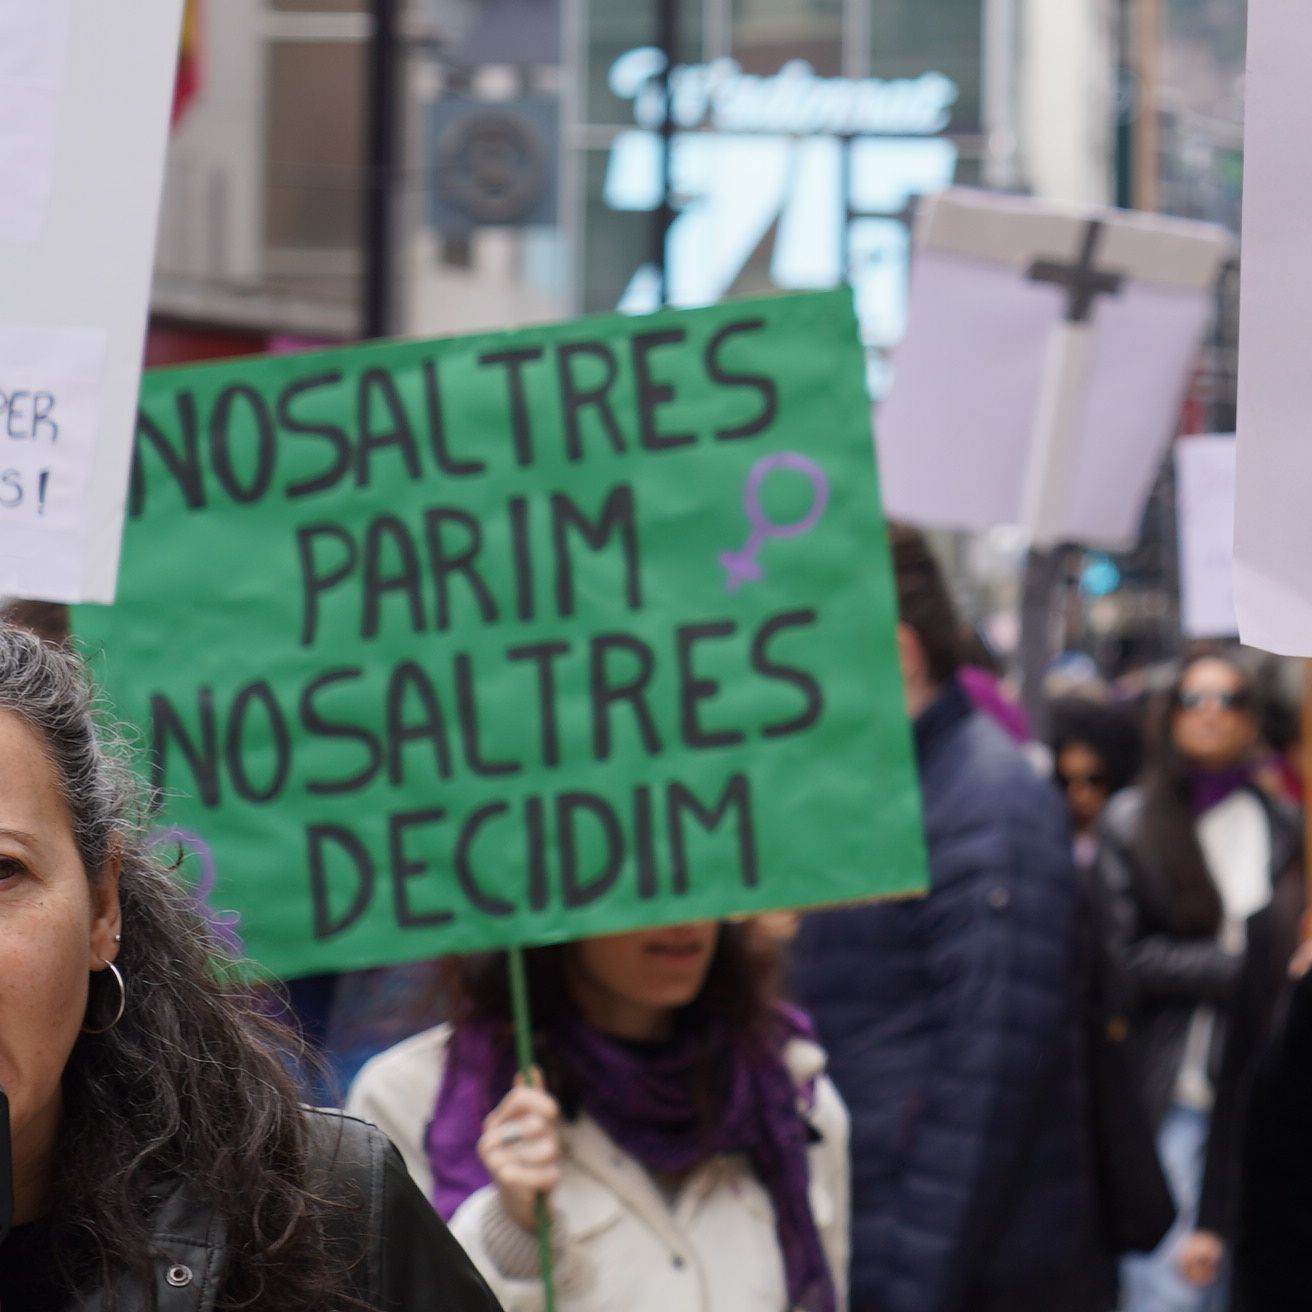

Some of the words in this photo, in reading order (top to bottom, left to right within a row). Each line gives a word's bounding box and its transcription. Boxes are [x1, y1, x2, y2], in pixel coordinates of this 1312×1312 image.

[129, 320, 780, 521] NOSALTRES
[295, 481, 643, 647] PARIM
[147, 608, 826, 812] NOSALTRES
[306, 772, 760, 943] DECIDIM
